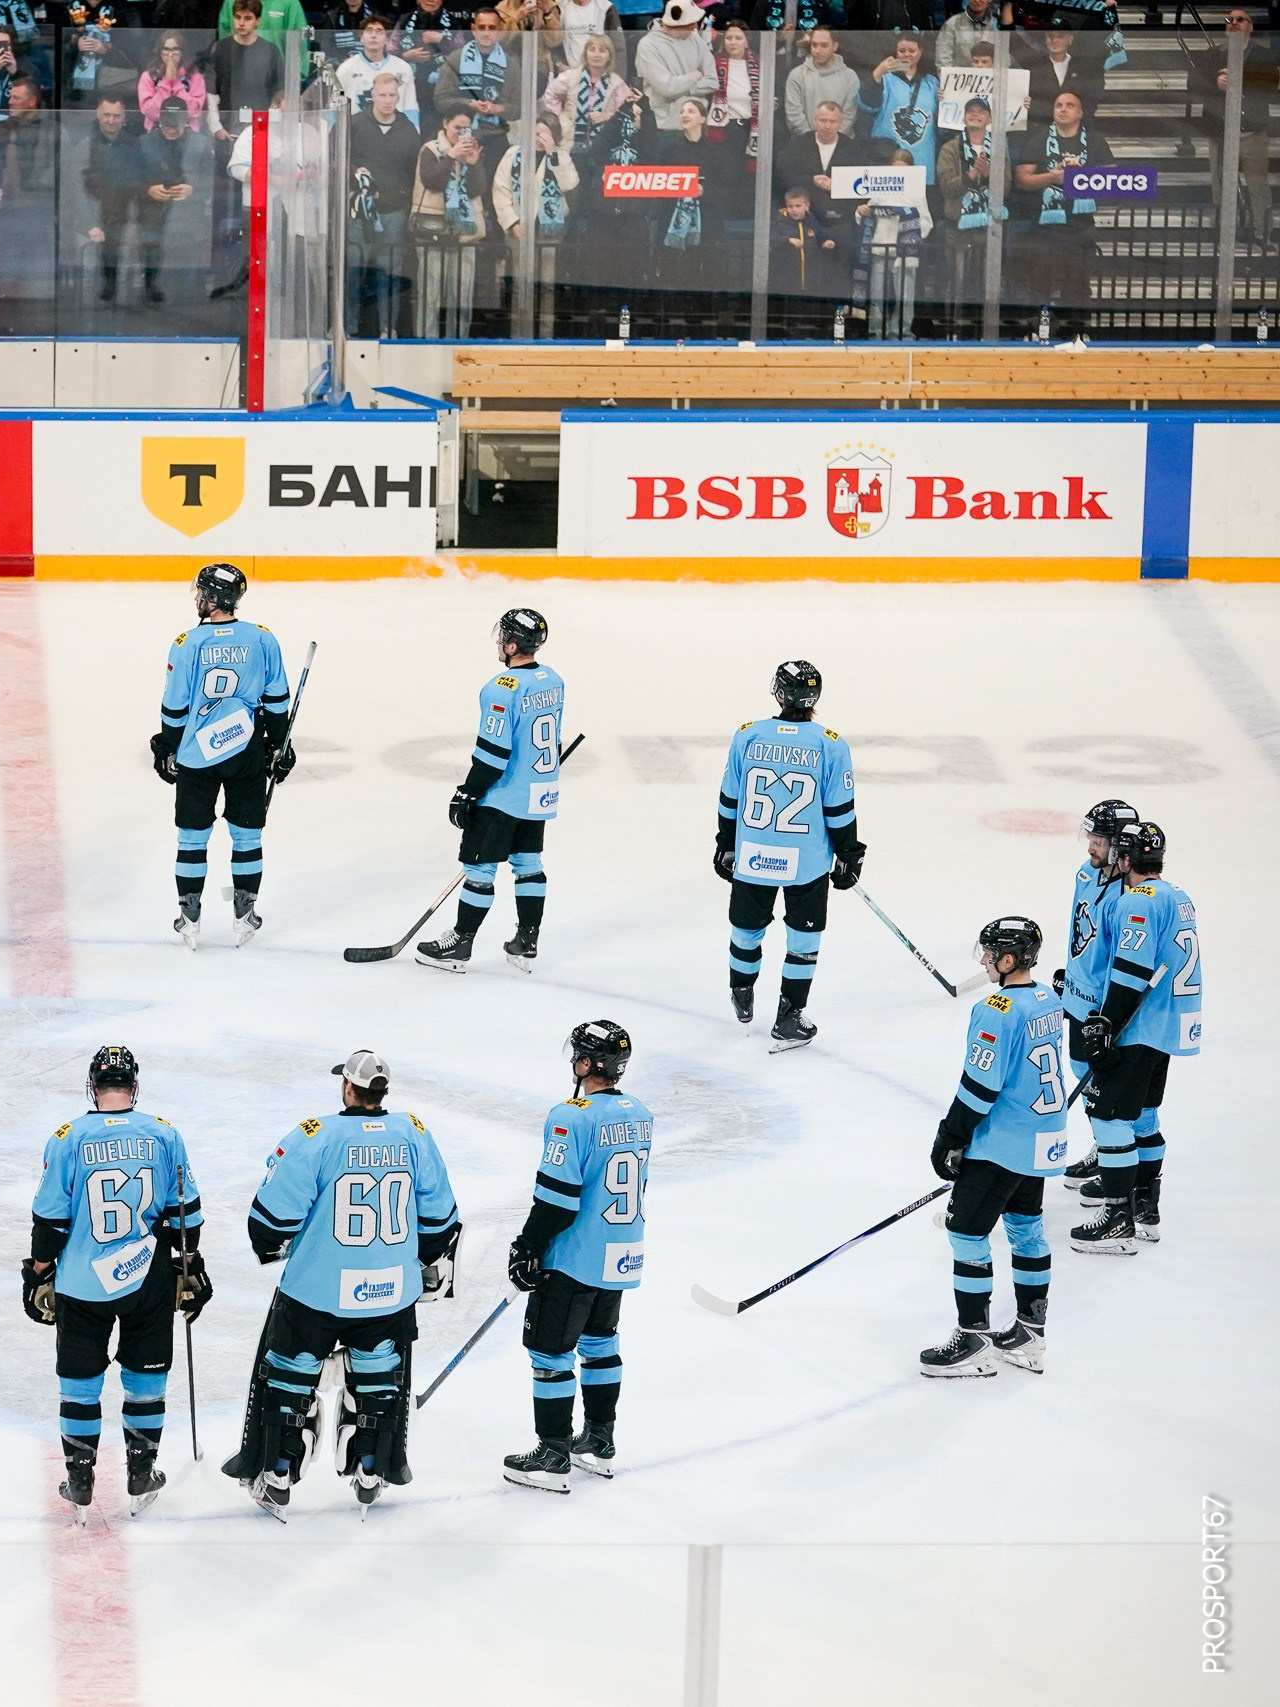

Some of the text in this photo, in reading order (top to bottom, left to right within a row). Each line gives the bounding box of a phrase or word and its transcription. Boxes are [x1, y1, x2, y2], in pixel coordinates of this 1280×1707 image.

[606, 173, 697, 191] FONBET
[870, 176, 905, 185] ГАЗПРОМ
[626, 476, 1113, 520] BSB Bank
[200, 646, 249, 665] LIPSKY
[198, 667, 240, 716] 9
[497, 682, 514, 690] LINE
[485, 715, 505, 737] 91
[746, 742, 822, 768] LOZOVSKY
[742, 766, 818, 834] 62
[1151, 837, 1162, 848] 27
[761, 856, 788, 867] ГАЗПРОМ
[1121, 928, 1148, 951] 27
[987, 1000, 1008, 1012] LINE
[990, 994, 1009, 1004] MAX
[1075, 987, 1099, 1005] Bank
[968, 1042, 996, 1072] 38
[83, 1138, 156, 1166] OUELLET
[348, 1144, 408, 1168] FUCALE
[543, 1142, 568, 1166] 96
[85, 1166, 155, 1245] 61
[332, 1171, 413, 1247] 60
[903, 1193, 934, 1216] BAUER
[1101, 1221, 1128, 1240] CCM
[124, 1245, 149, 1271] ГАЗПРОМ
[368, 1281, 395, 1292] ГАЗПРОМ
